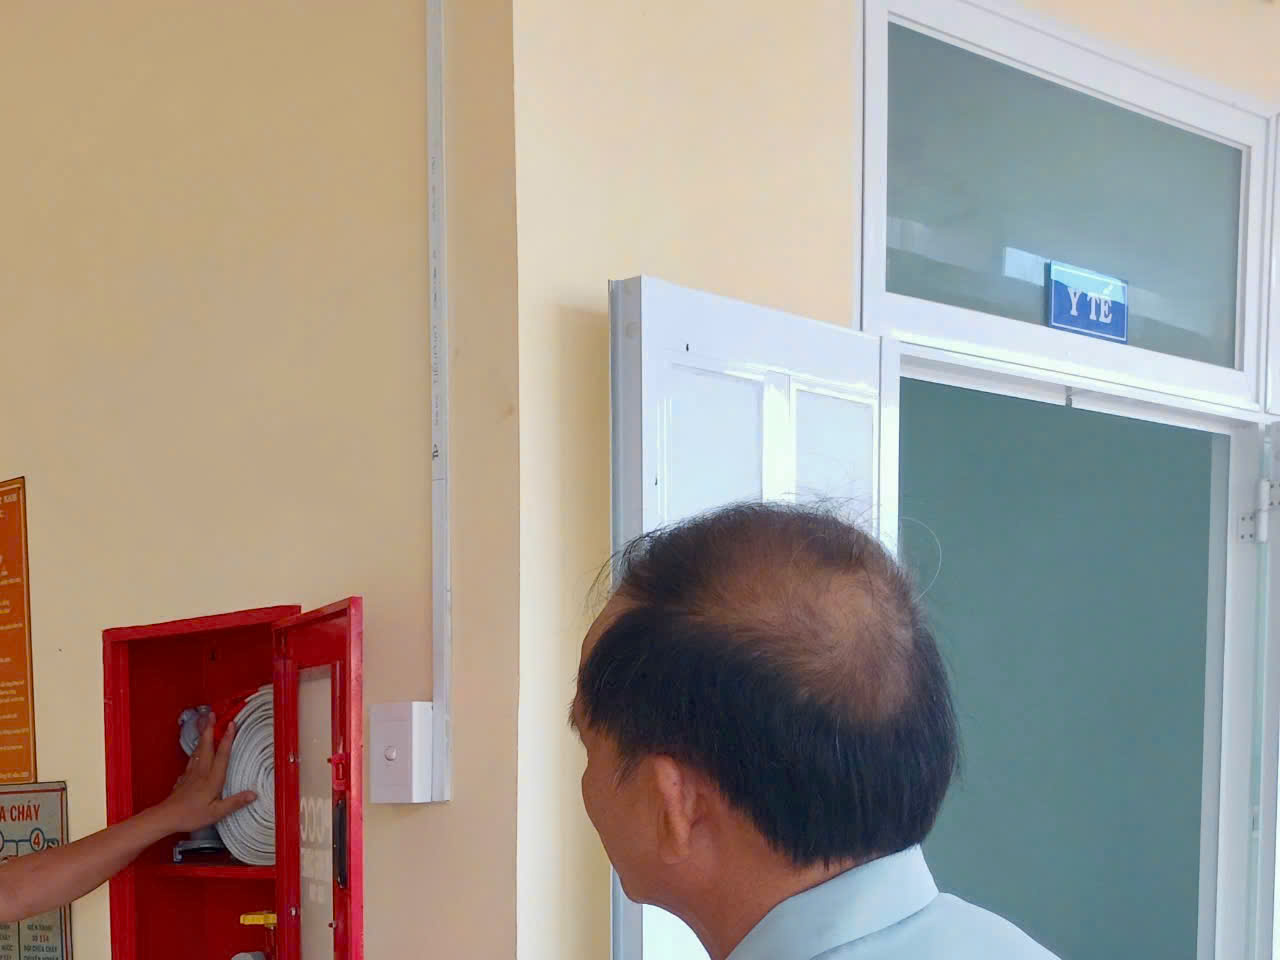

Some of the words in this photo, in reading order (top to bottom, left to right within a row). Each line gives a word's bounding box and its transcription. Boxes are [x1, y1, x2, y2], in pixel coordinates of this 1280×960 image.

[1067, 287, 1082, 317] Y
[1086, 284, 1113, 324] TẾ
[10, 800, 40, 822] CHÁY
[33, 833, 41, 848] 4
